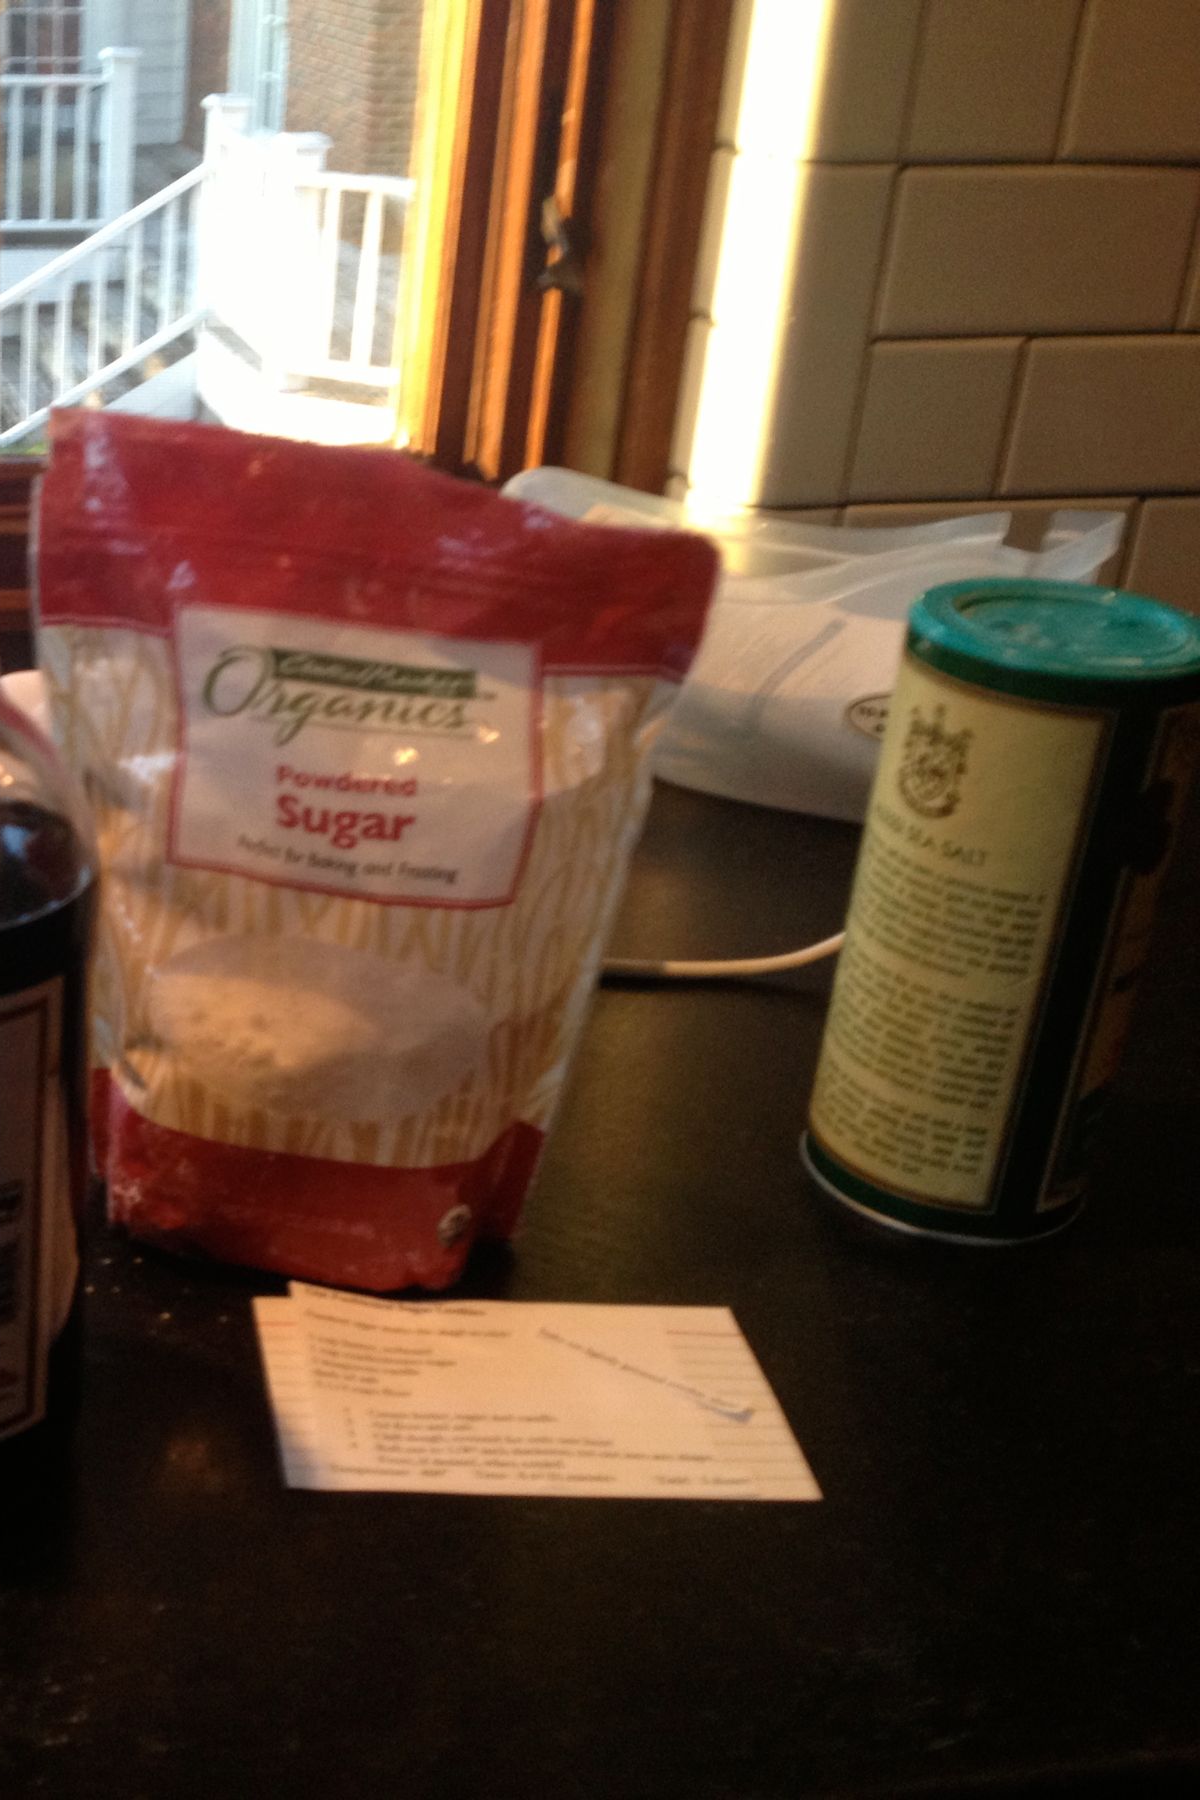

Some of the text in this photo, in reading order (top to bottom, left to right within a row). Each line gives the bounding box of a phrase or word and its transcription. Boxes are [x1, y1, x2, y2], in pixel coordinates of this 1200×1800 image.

[203, 645, 469, 747] Organics
[276, 764, 418, 797] Powdered
[276, 794, 417, 850] Sugar
